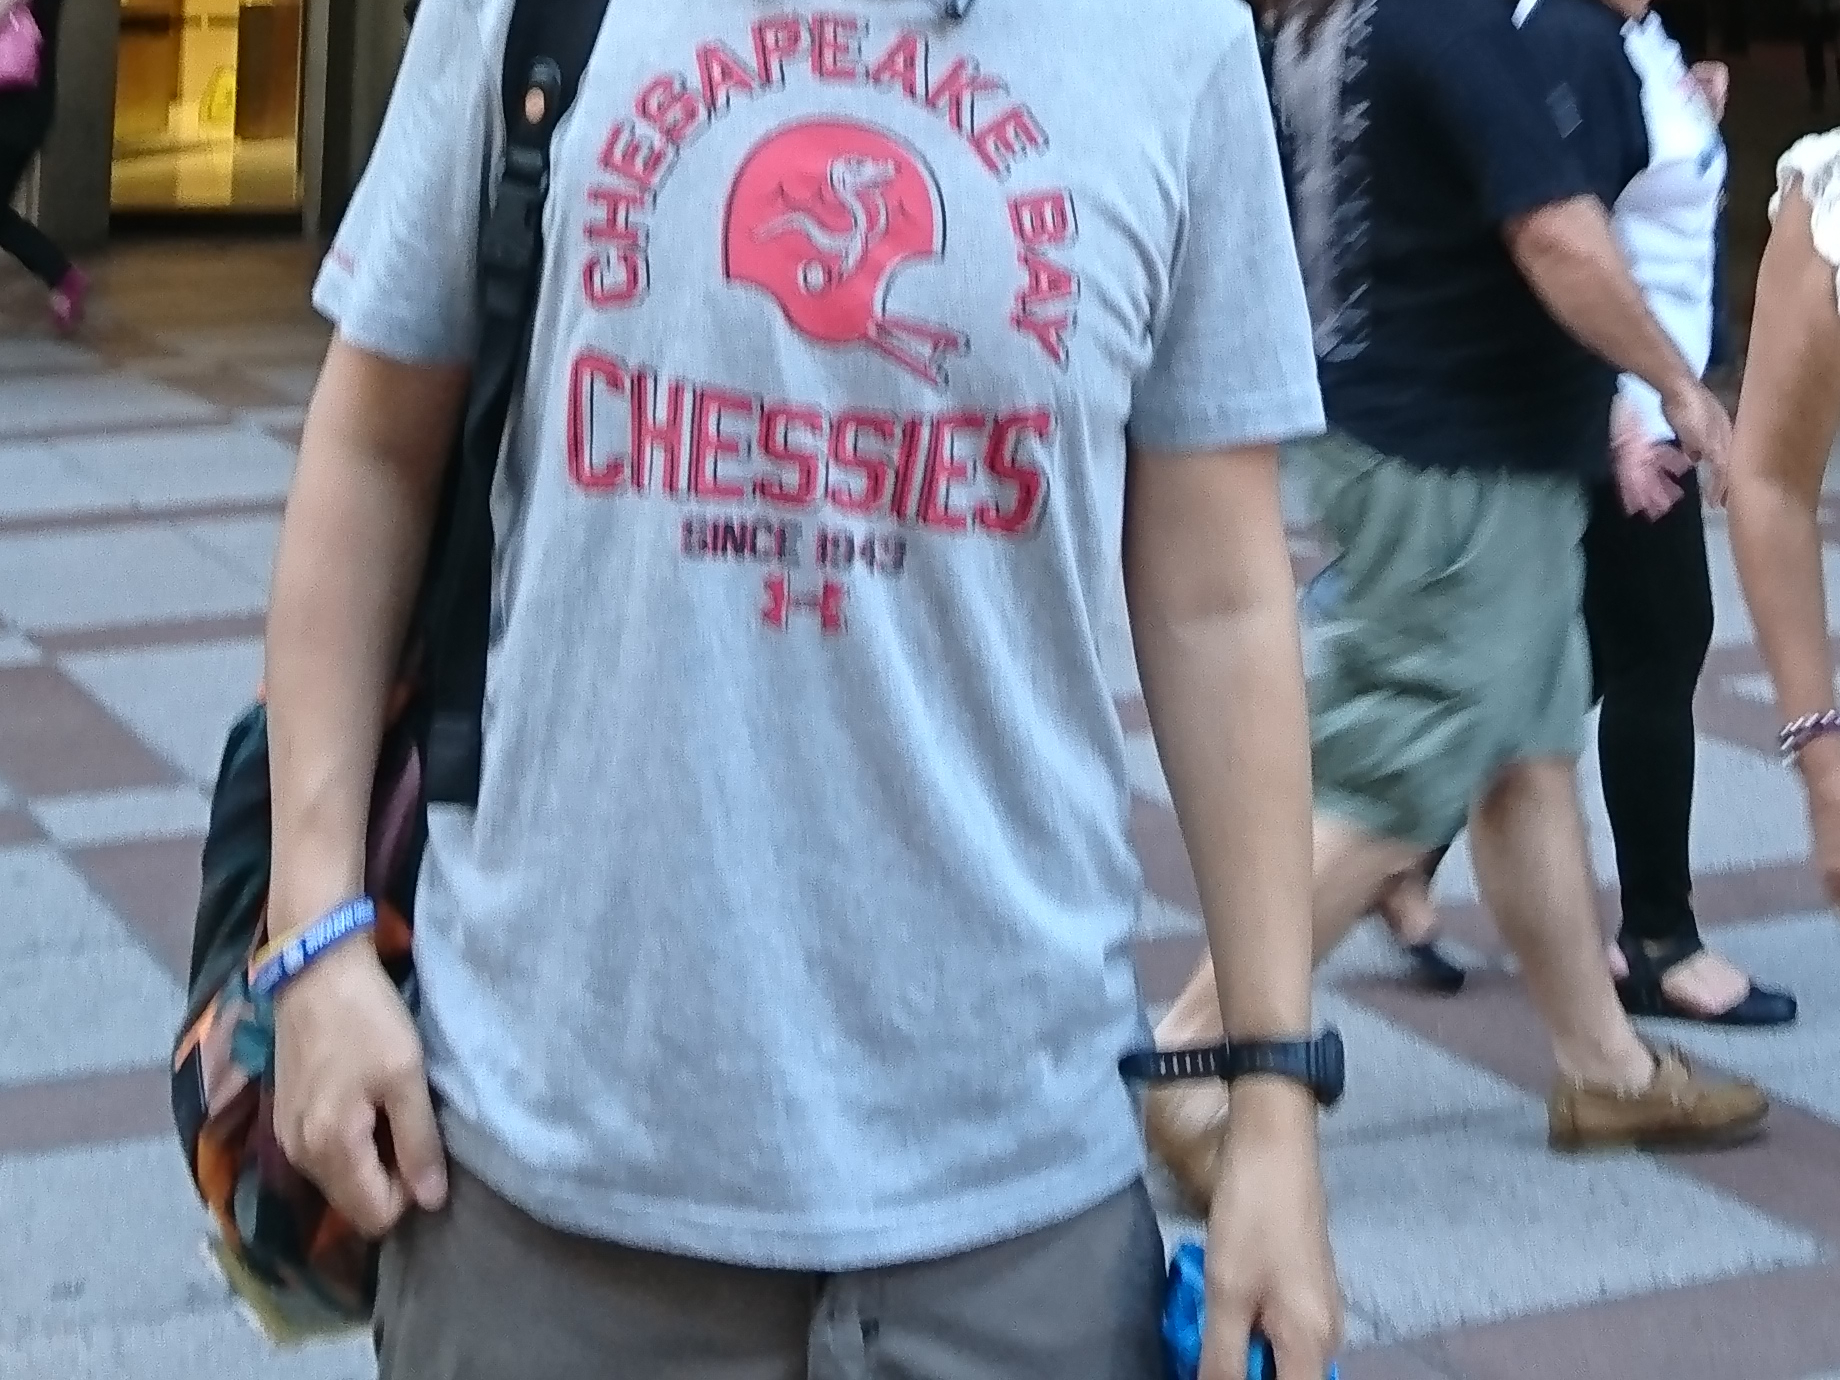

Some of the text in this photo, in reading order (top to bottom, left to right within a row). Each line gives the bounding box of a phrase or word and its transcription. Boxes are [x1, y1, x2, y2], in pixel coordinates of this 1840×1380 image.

[581, 11, 1082, 373] CHESAPEAKE BAY
[567, 344, 1054, 536] CHESSIES
[679, 514, 803, 568] SINCE
